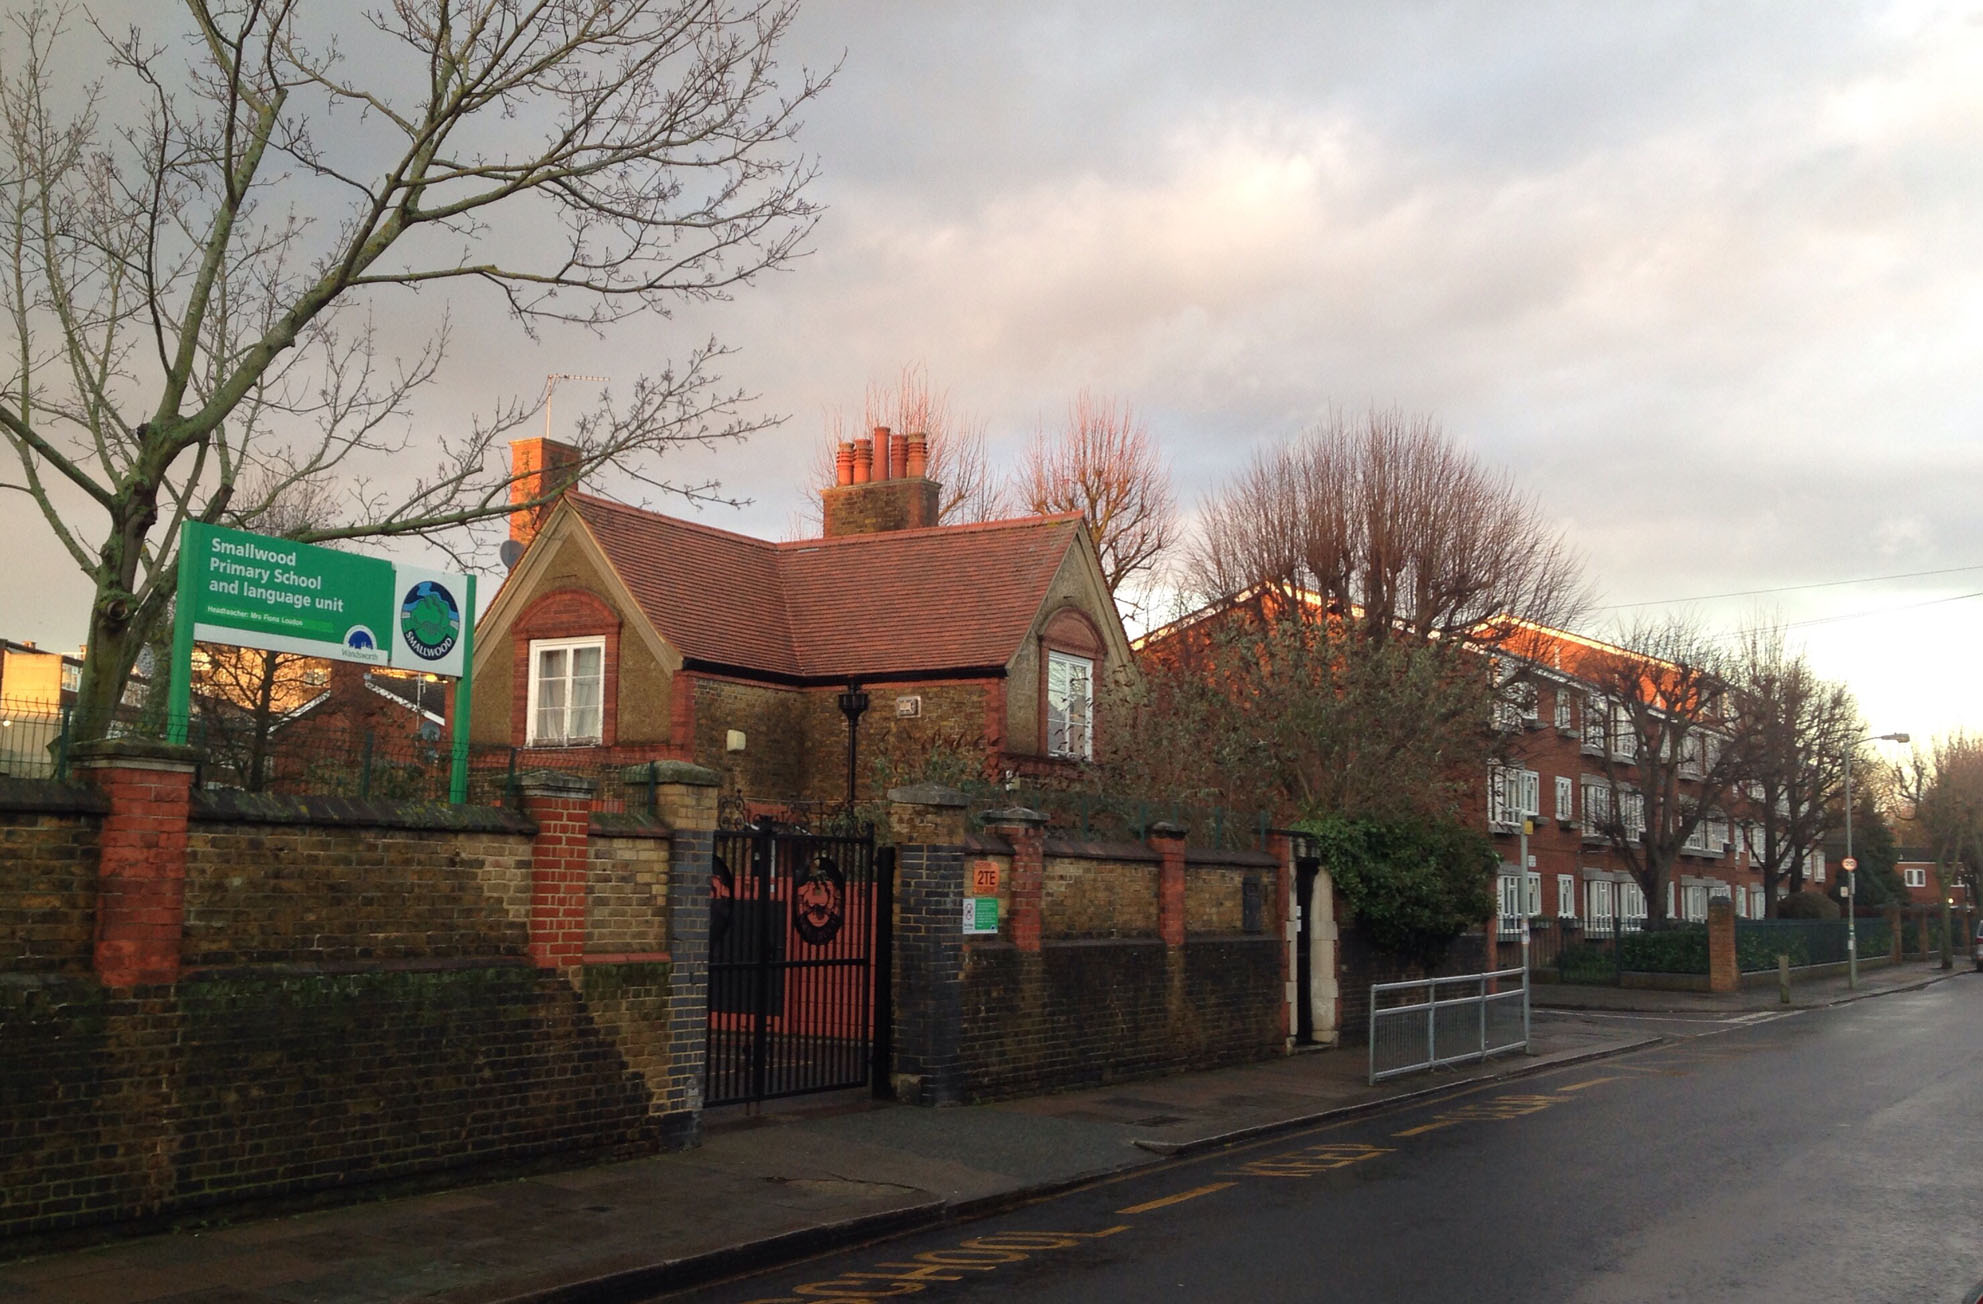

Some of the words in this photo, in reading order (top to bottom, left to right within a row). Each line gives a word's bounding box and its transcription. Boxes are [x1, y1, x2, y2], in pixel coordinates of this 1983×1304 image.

[212, 538, 296, 566] Smallwood
[210, 557, 270, 583] Primary
[274, 569, 321, 590] School
[209, 579, 239, 595] and
[243, 582, 311, 608] language
[315, 597, 344, 612] unit
[250, 611, 262, 621] Mrs
[405, 630, 453, 657] SMALLWOOD
[977, 870, 996, 885] 2TE
[1214, 1143, 1398, 1177] KEEP
